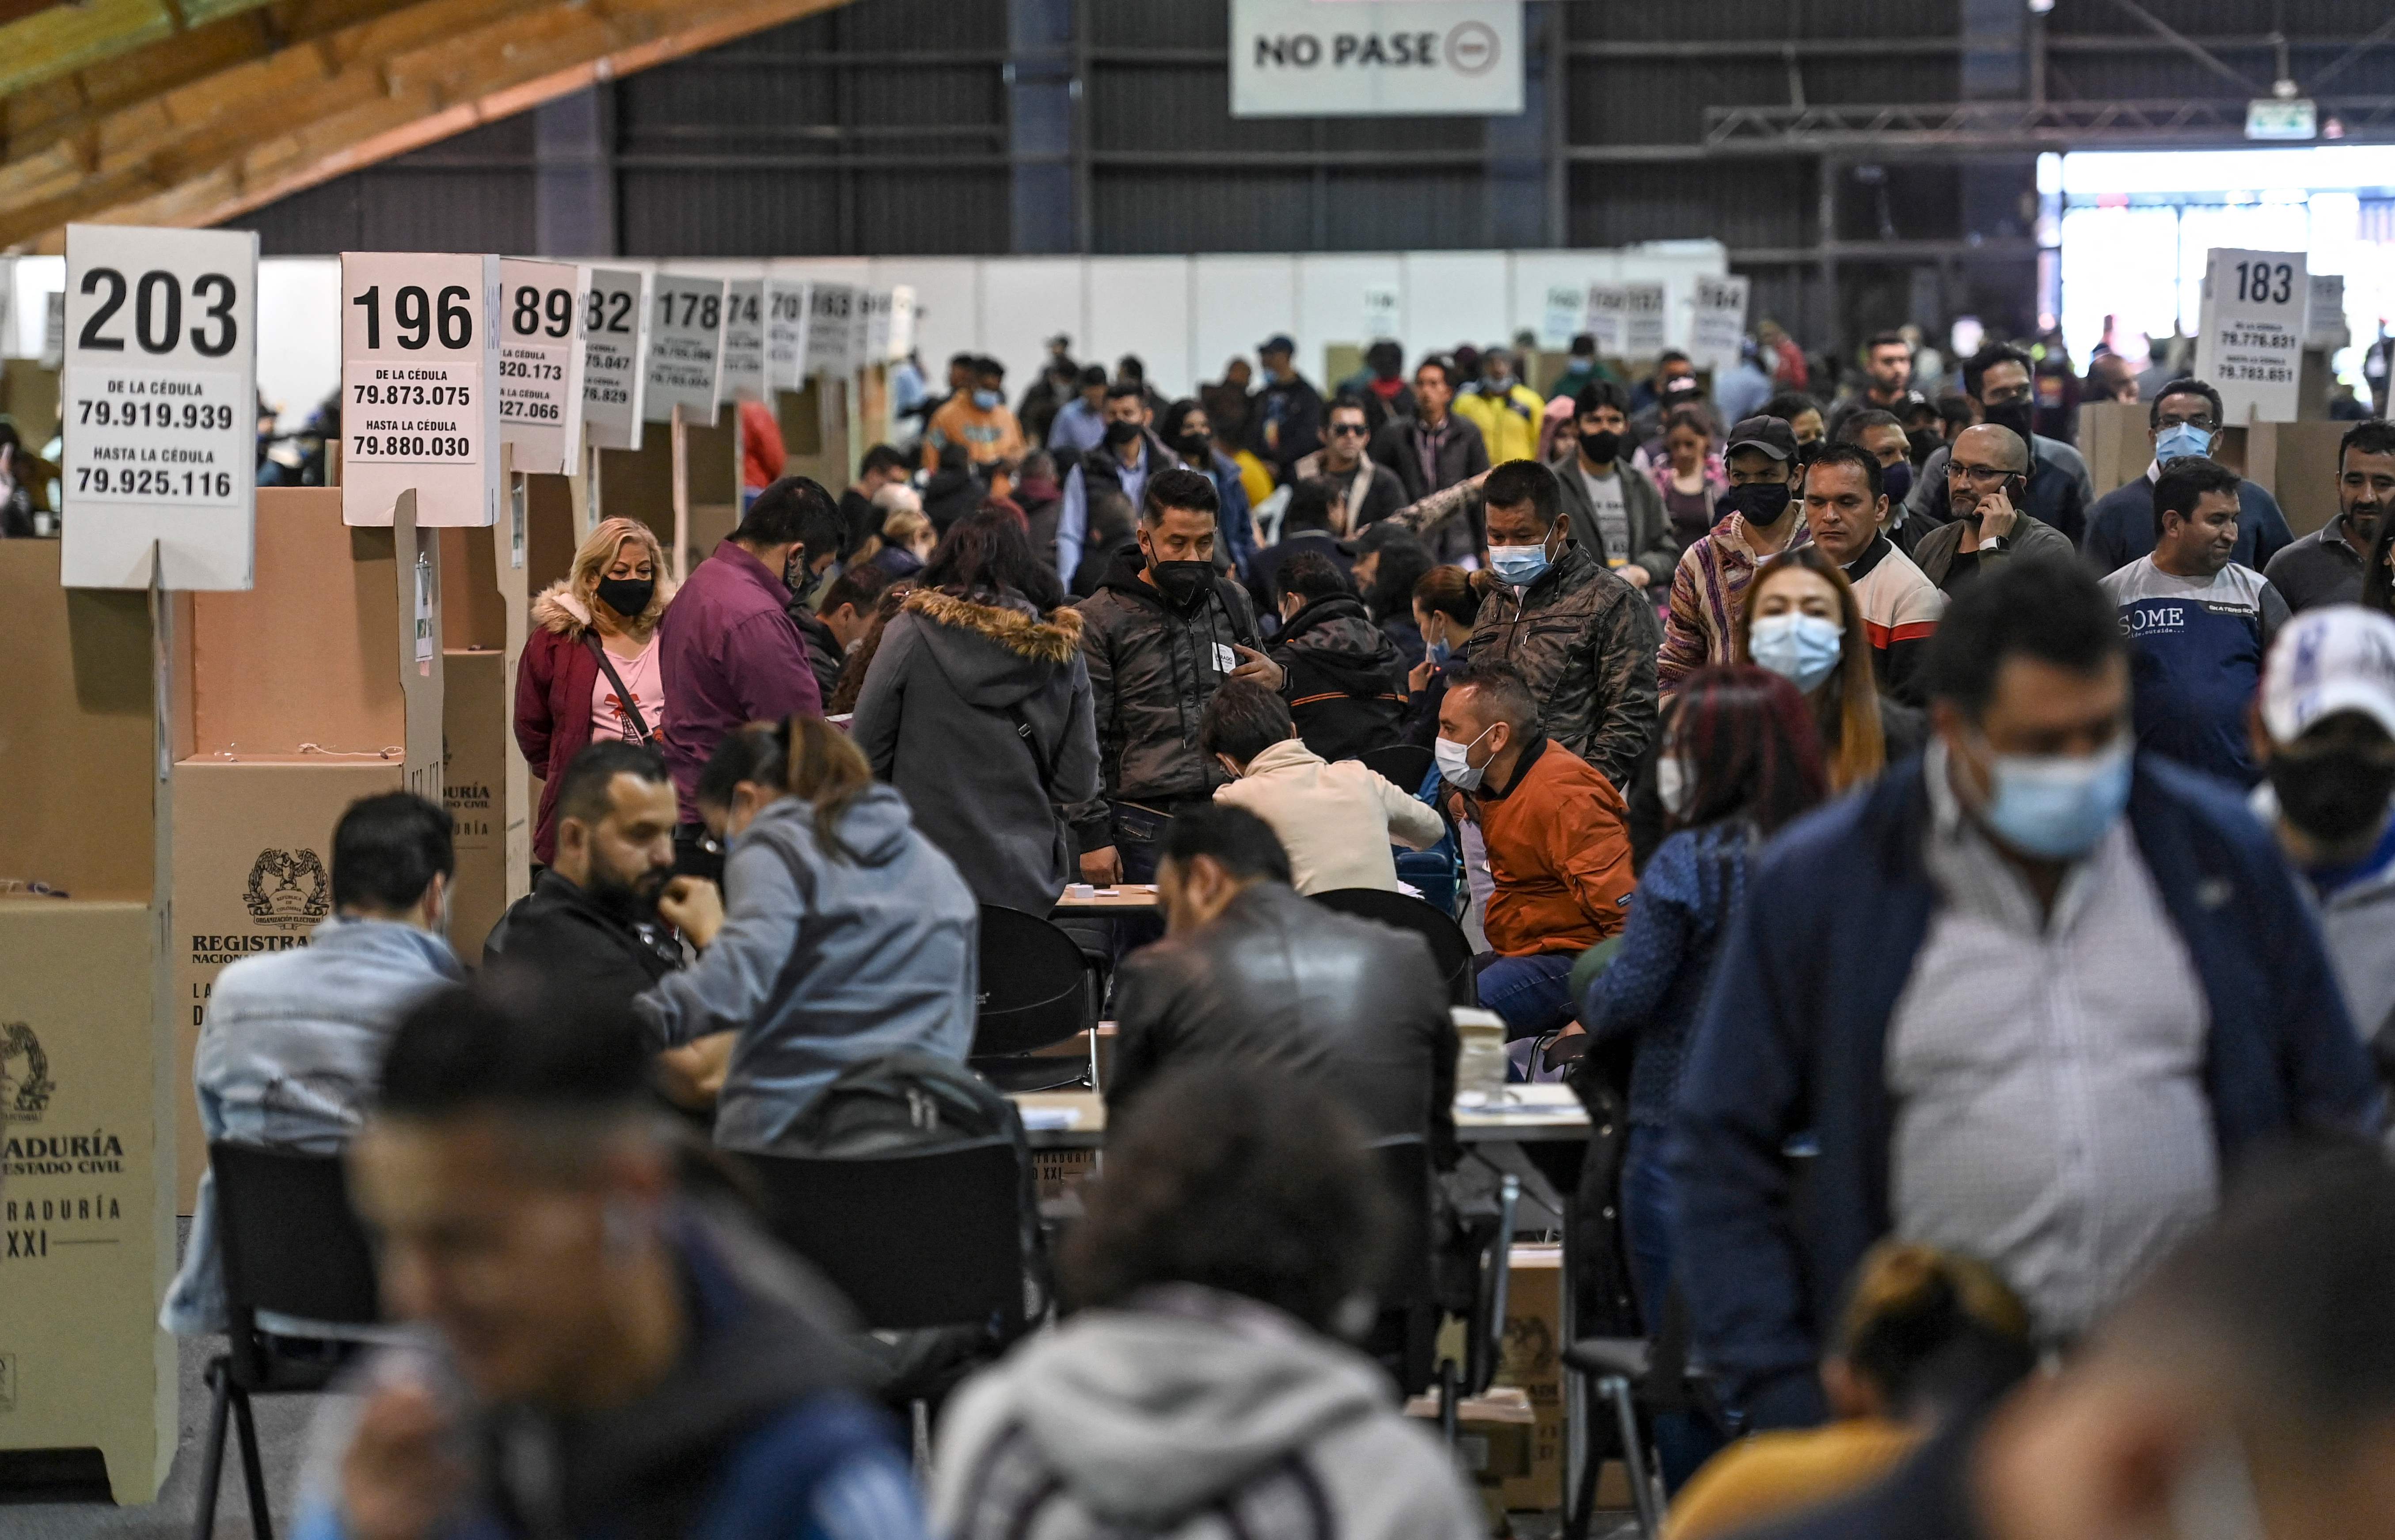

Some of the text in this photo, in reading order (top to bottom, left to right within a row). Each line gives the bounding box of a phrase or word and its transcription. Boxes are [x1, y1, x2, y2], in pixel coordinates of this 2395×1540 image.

[1255, 32, 1440, 67] NO PASE
[2235, 260, 2294, 304] 183
[78, 267, 237, 357] 203
[353, 285, 472, 350] 196
[500, 283, 572, 338] 89
[659, 290, 719, 330] 178
[514, 349, 545, 360] CÉDULA
[376, 368, 448, 381] DE LA CÉDULA
[107, 379, 202, 396] DE LA CÉDULA
[354, 385, 470, 406] 79.873.075
[507, 388, 517, 397] LA
[519, 387, 550, 400] CÉDULA
[77, 400, 232, 429] 79.919.939
[366, 419, 456, 432] HASTA LA CÉDULA
[93, 447, 214, 463] HASTA LA CÉDULA
[353, 436, 469, 457] 79.880.030
[76, 468, 230, 497] 79.925.116
[2209, 605, 2242, 614] SKATERS
[2118, 608, 2184, 635] SOME
[464, 800, 489, 809] CIVIL
[256, 915, 292, 923] ORGANIZACIÓN
[193, 982, 212, 998] LA
[1, 1159, 123, 1175] ESTADO CIVIL
[7, 1194, 120, 1221] RADURÍA
[7, 1229, 47, 1258] XXI
